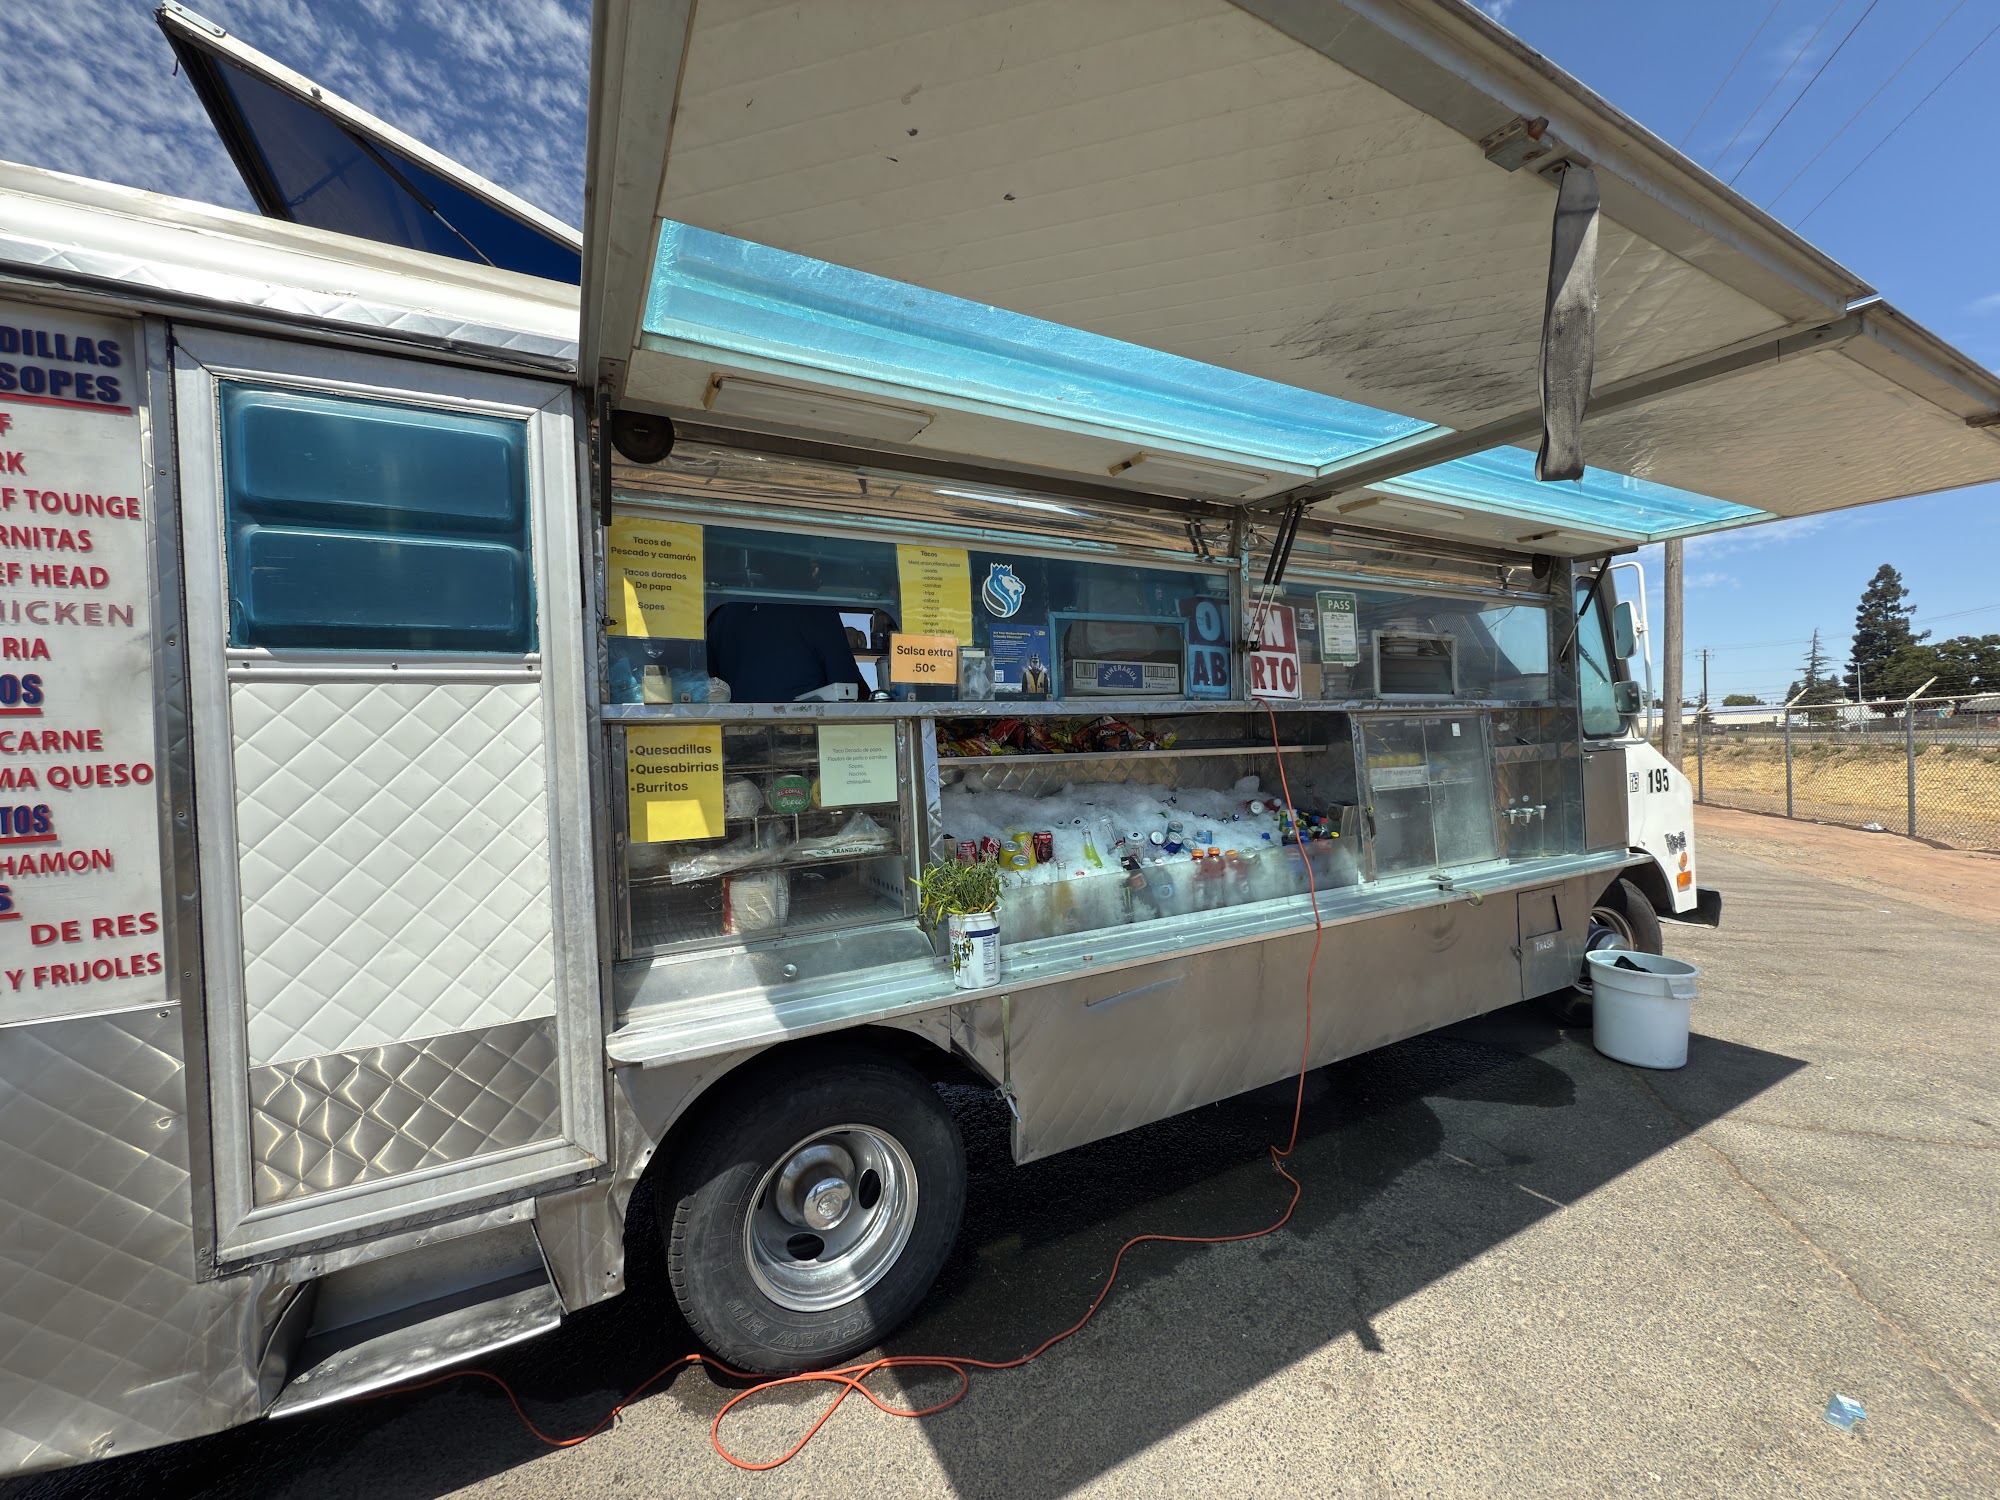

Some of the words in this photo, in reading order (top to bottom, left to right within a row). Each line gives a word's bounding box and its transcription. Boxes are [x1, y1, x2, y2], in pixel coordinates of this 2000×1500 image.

[0, 361, 121, 403] SOPES
[23, 489, 141, 520] TOUNGE
[633, 536, 659, 546] Tacos
[611, 547, 649, 557] Pescado
[658, 553, 697, 561] camarón
[30, 563, 111, 588] HEAD
[623, 567, 650, 577] Tacos
[651, 571, 687, 580] dorados
[0, 600, 134, 627] ICKEN
[637, 601, 666, 611] Sopes
[1327, 600, 1351, 611] PASS
[2, 637, 51, 660] RIA
[897, 645, 925, 656] Salsa
[927, 648, 954, 658] extra
[1103, 664, 1138, 682] MINERAGUA
[0, 729, 104, 754] CARNE
[635, 744, 712, 757] Quesadillas
[635, 762, 719, 775] Quesabirrias
[47, 763, 154, 791] QUESO
[1631, 777, 1638, 790] 15
[1648, 768, 1669, 793] 195
[636, 782, 689, 793] Burritos
[31, 920, 82, 946] DE
[93, 912, 160, 940] RES
[1536, 939, 1554, 951] TRASH
[5, 969, 24, 991] Y
[33, 952, 163, 988] FRIJOLES
